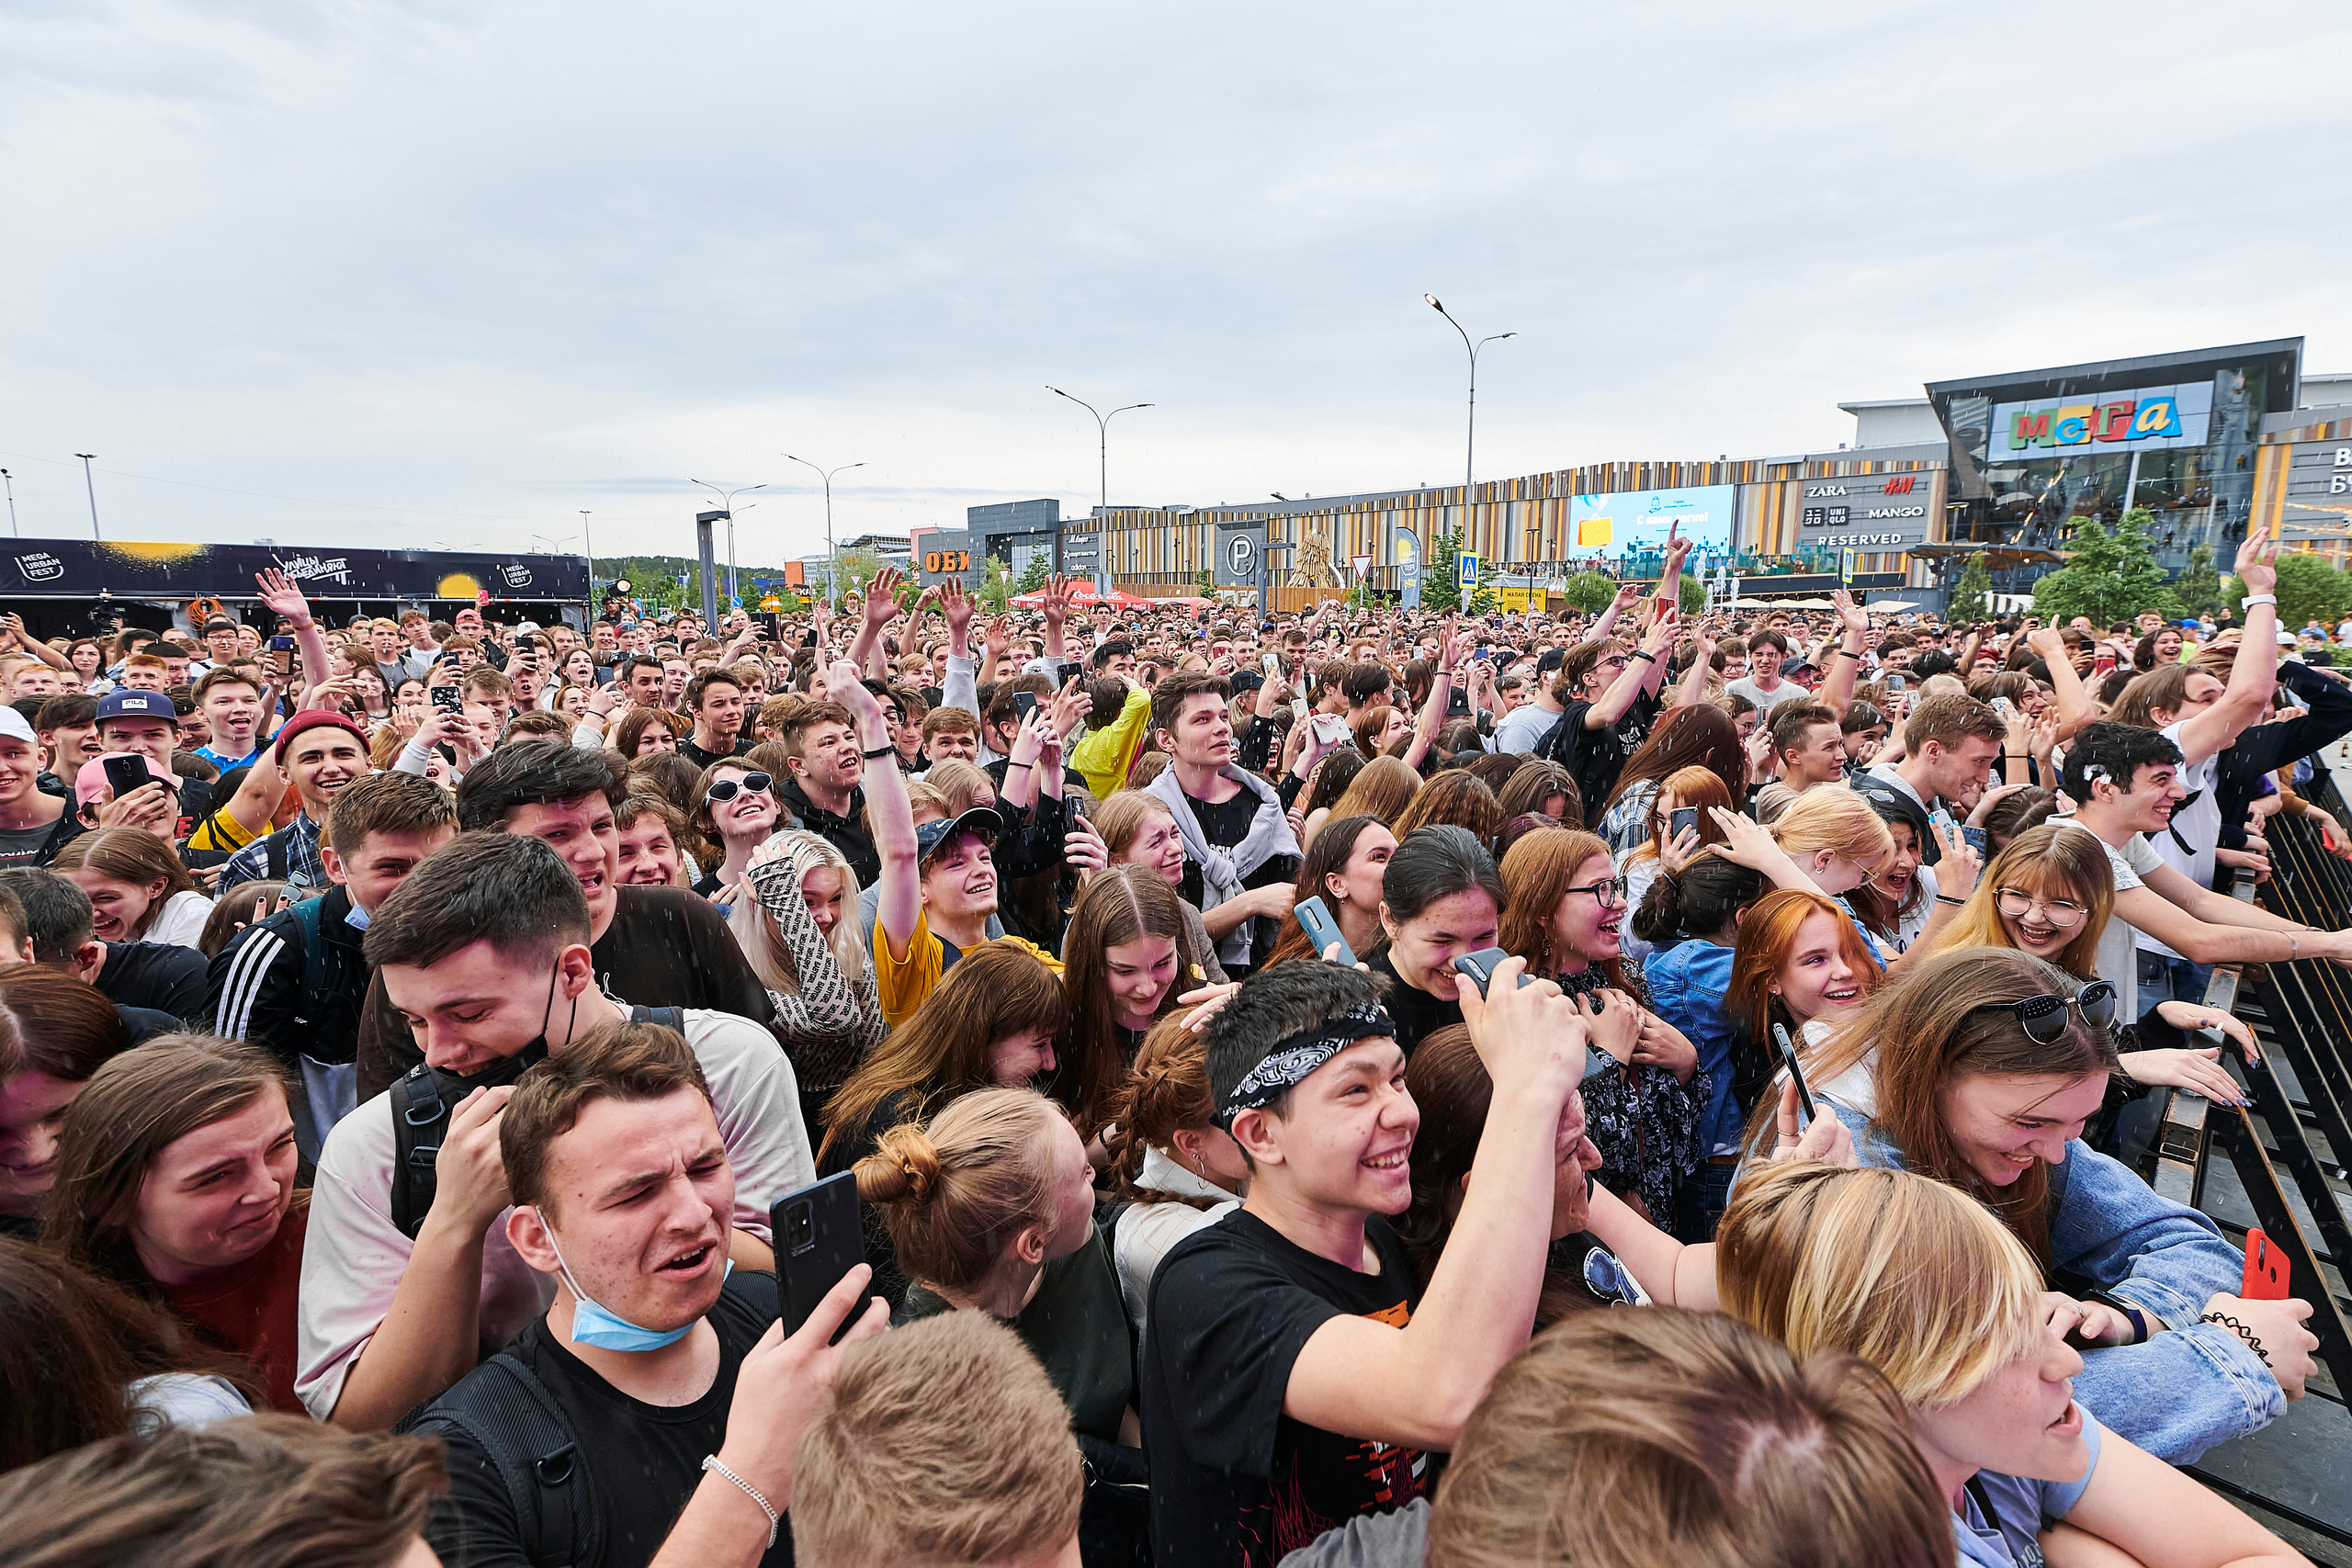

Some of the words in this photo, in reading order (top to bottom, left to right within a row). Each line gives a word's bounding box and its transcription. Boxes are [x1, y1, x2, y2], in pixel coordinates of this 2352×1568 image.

[1883, 476, 1915, 495] H&M
[1808, 486, 1847, 497] ZARA
[1869, 506, 1923, 519] MANGO
[1818, 534, 1902, 546] RESERVED
[21, 552, 51, 562] MEGA
[926, 551, 969, 572] ОБИ
[26, 558, 61, 570] URBAN
[505, 564, 525, 572] MEGA
[29, 567, 54, 577] FEST
[508, 569, 531, 579] URBAN
[510, 576, 526, 584] FEST
